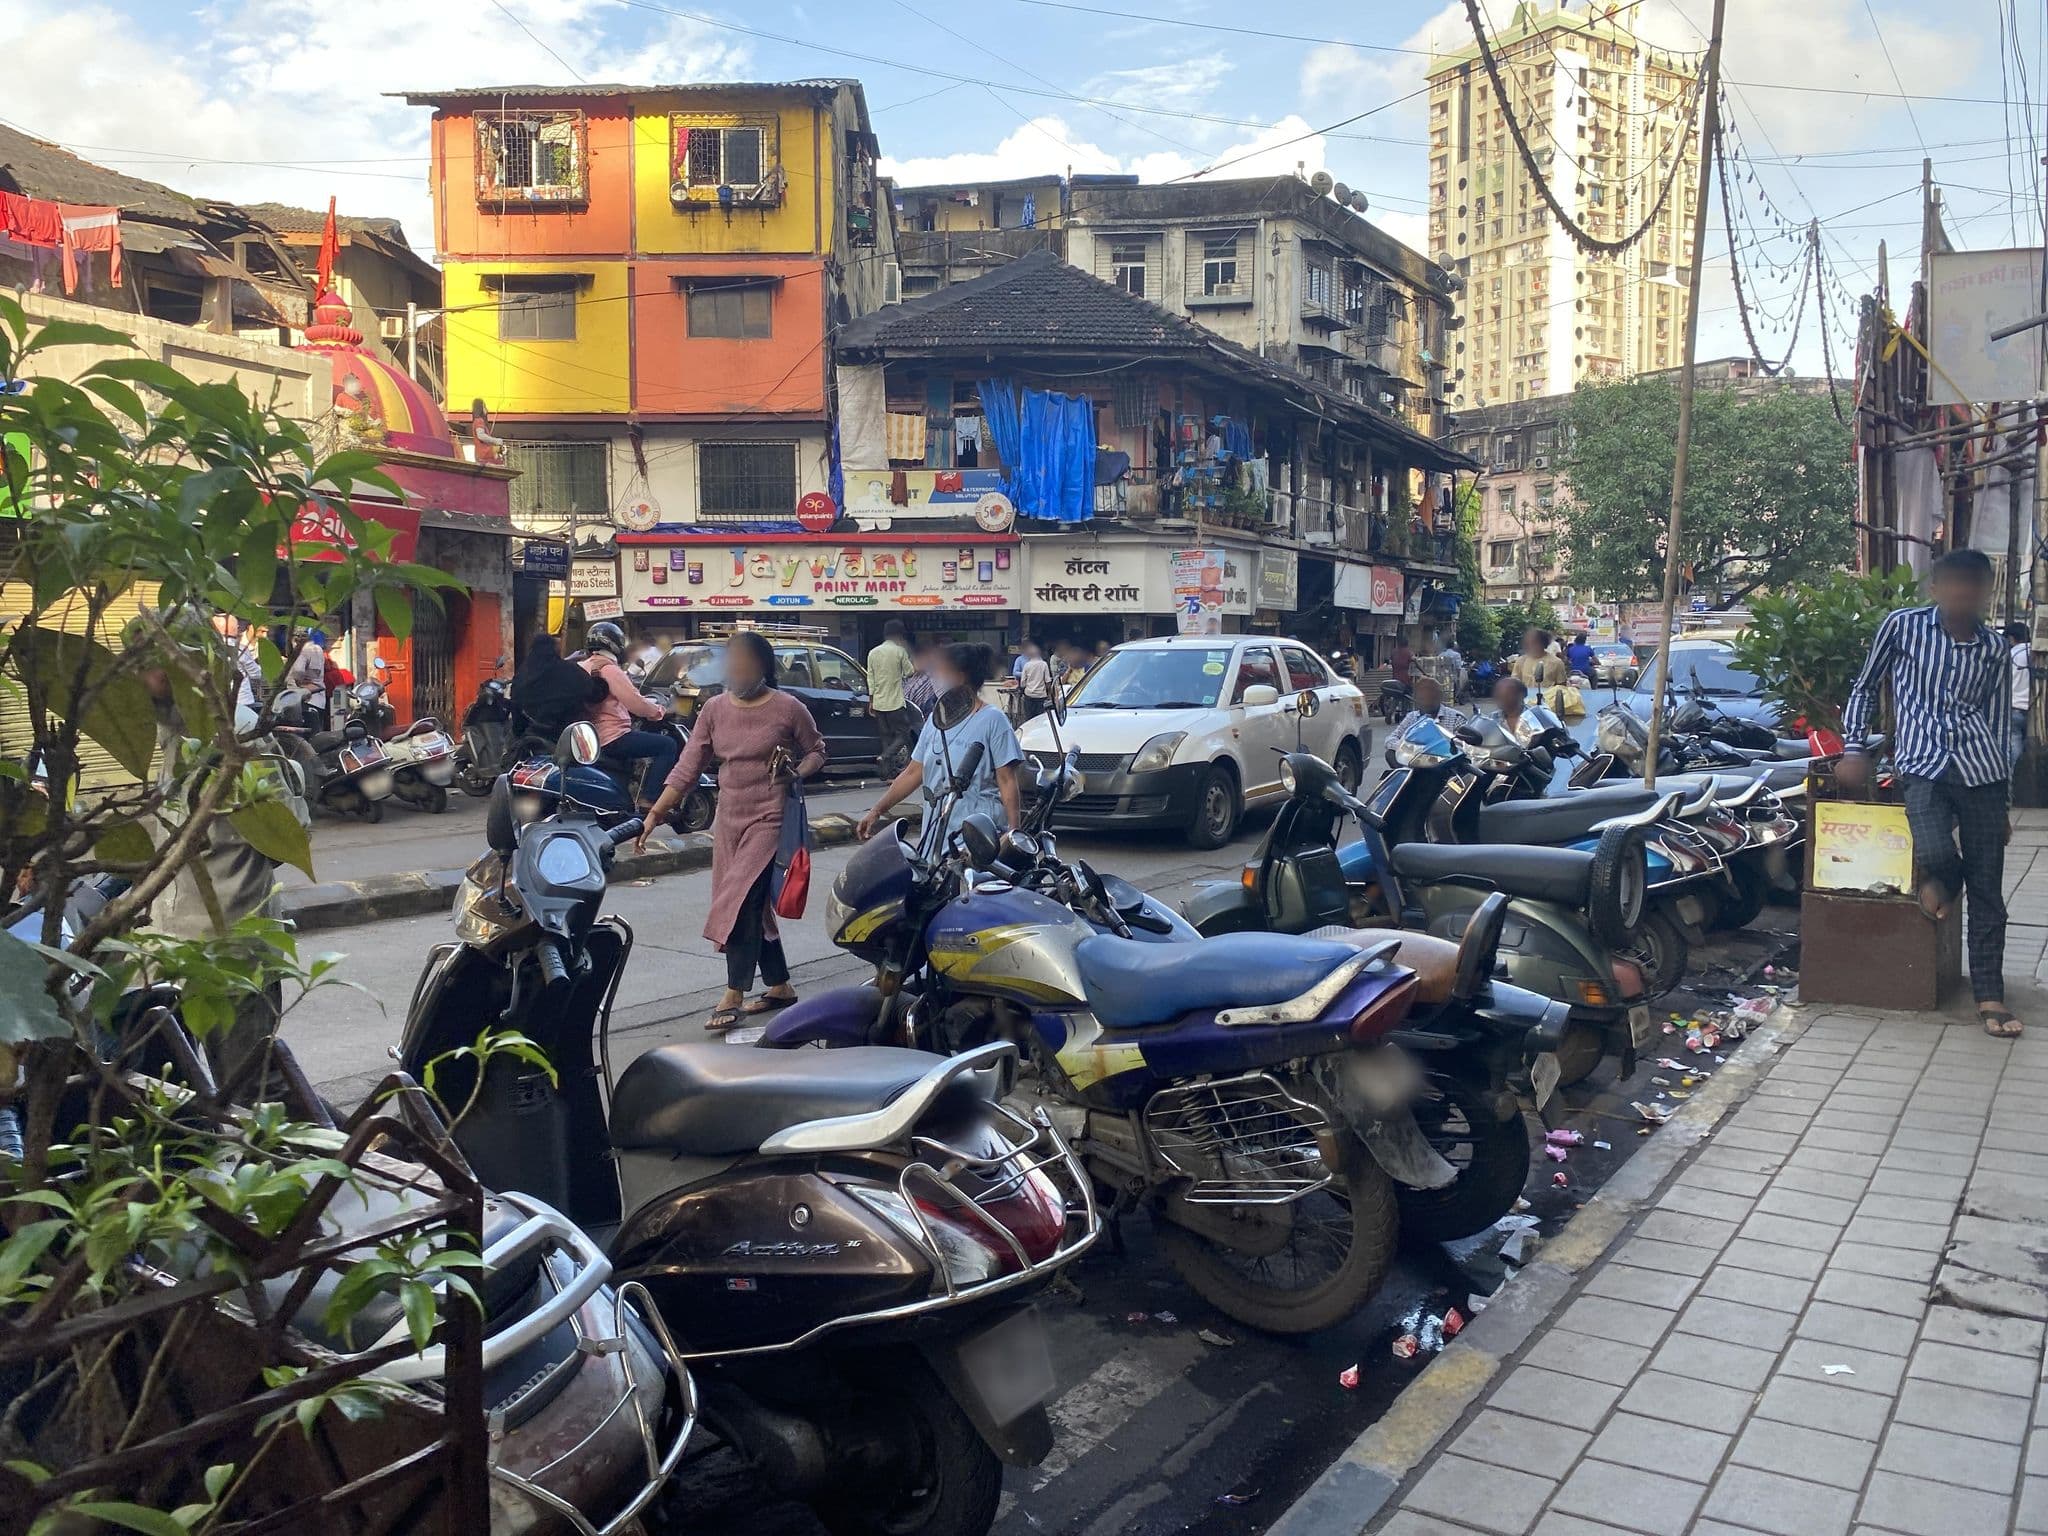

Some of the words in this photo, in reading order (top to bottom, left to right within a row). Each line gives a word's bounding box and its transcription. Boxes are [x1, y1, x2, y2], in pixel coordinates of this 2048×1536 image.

[799, 512, 833, 520] asianpaints
[729, 547, 917, 587] Jaywant
[1064, 557, 1110, 575] हॉटल
[590, 577, 615, 588] Steels
[814, 581, 858, 592] PAINT
[865, 581, 907, 592] MART
[1033, 582, 1080, 603] संदिप
[1082, 583, 1102, 601] टी
[1104, 584, 1140, 602] शॉप
[653, 597, 681, 605] BERGER
[775, 597, 801, 605] JOTUN
[1184, 596, 1200, 614] 75
[496, 1362, 560, 1411] HONDA
